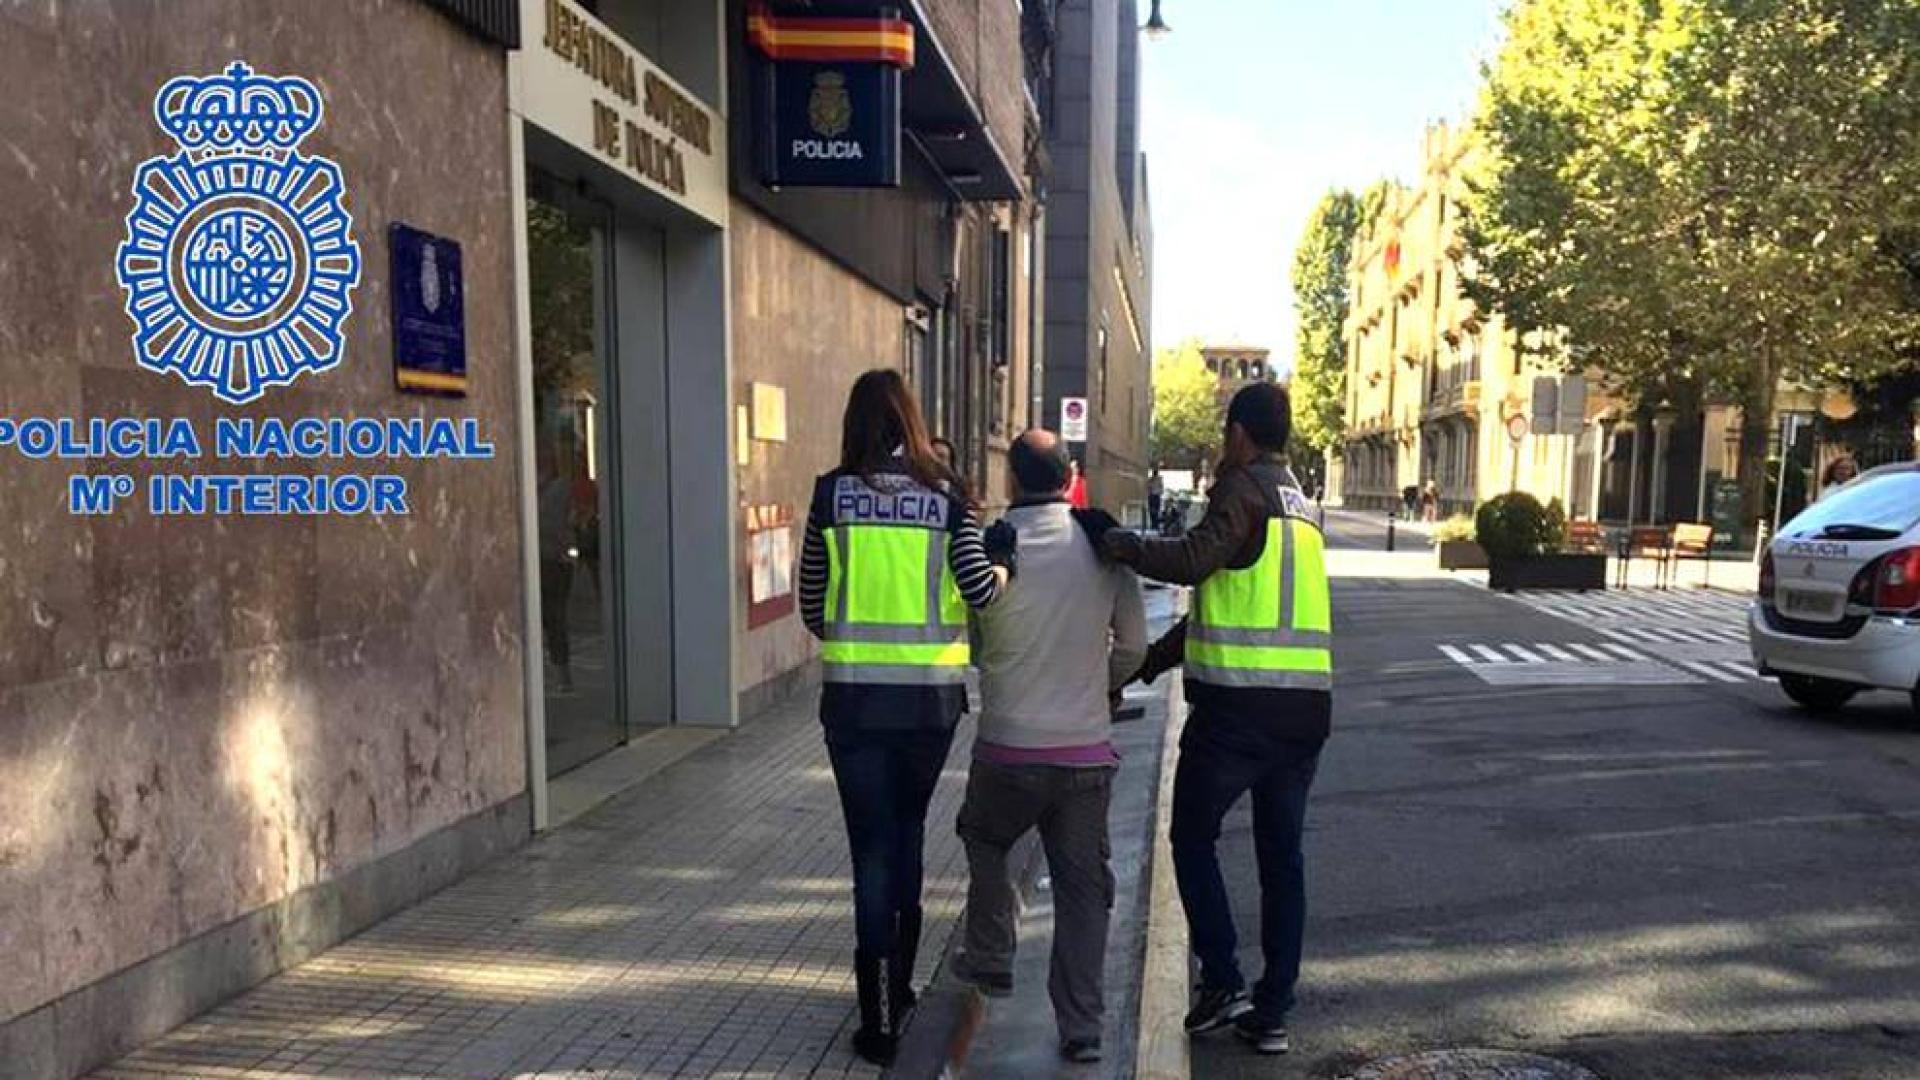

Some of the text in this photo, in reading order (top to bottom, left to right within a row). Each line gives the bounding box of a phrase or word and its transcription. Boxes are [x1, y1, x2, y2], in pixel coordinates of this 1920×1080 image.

[592, 98, 621, 159] DE
[792, 139, 863, 159] POLICIA
[837, 494, 942, 523] POLICIA
